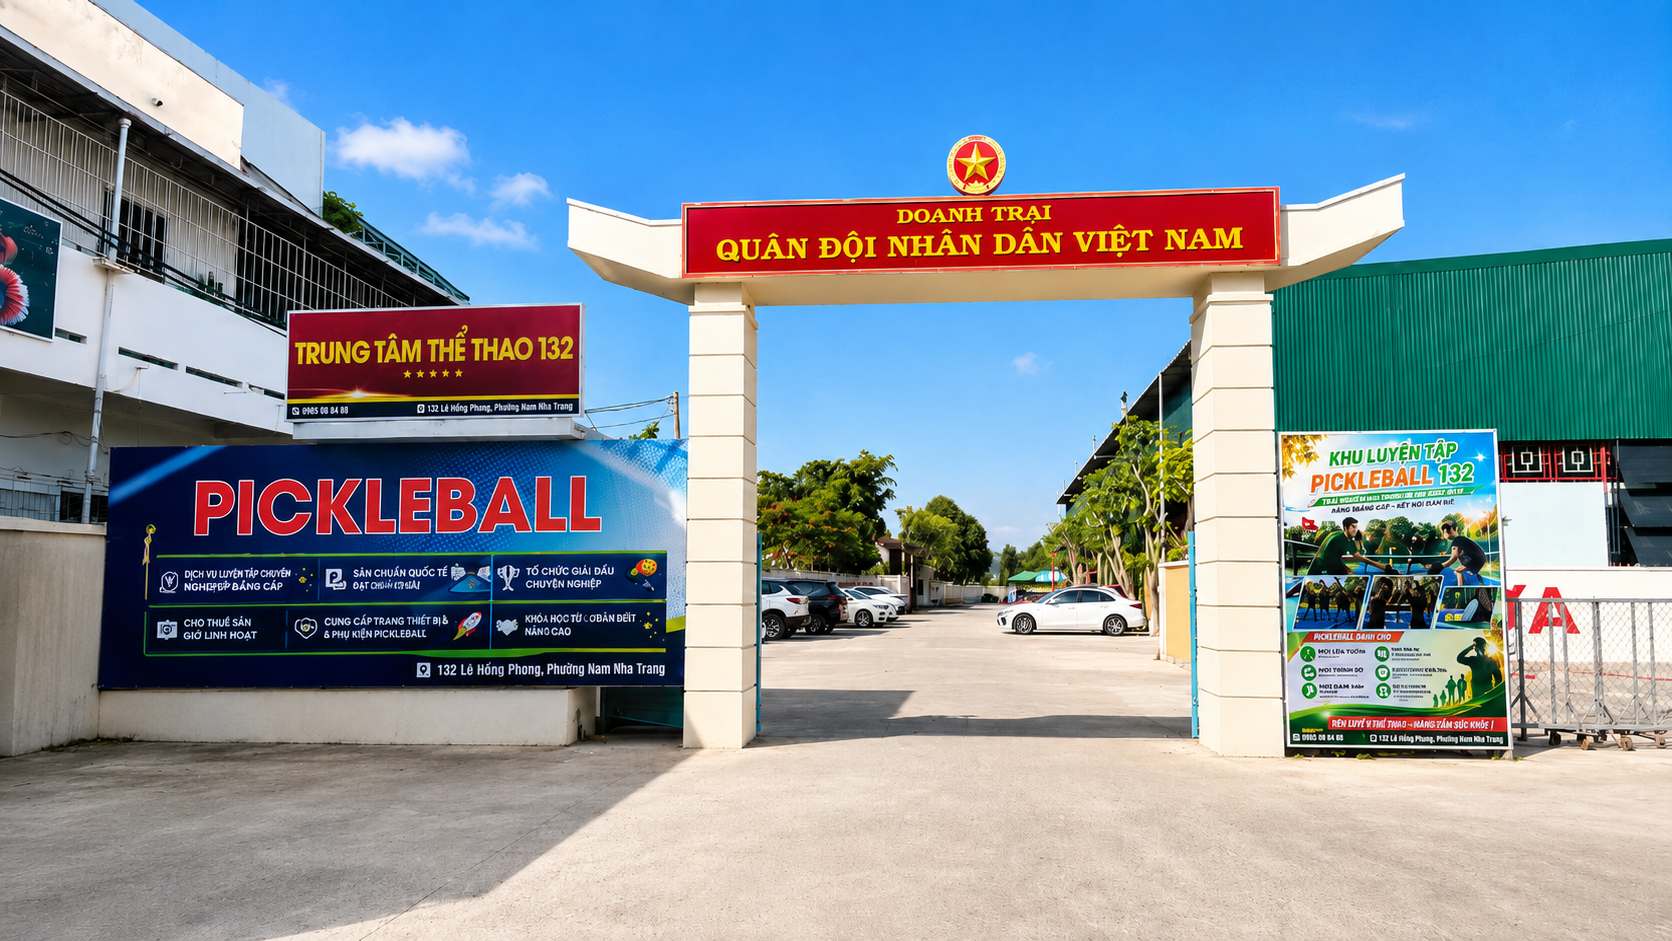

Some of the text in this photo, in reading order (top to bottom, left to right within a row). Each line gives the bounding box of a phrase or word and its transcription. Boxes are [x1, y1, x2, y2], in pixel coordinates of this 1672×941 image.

[897, 205, 1051, 225] DOANH TRẠI
[716, 223, 1244, 264] QUÂN ĐỘI NHÂN DÂN VIỆT NAM
[295, 325, 573, 364] TRUNG TÂM THỂ THAO 132
[427, 405, 438, 413] 132
[1329, 439, 1457, 467] KHU LUYỆN TẬP
[1311, 463, 1474, 493] PICKLEBALL 132
[193, 475, 602, 537] PICKLEBALL
[408, 565, 435, 577] QUỐC
[567, 578, 602, 590] NGHIỆP
[184, 619, 205, 628] CHO
[324, 617, 351, 626] CUNG
[373, 617, 404, 626] TRANG
[205, 631, 227, 640] LINH
[230, 631, 258, 642] HOẠT
[374, 629, 427, 639] PICKLEBALL
[551, 627, 571, 636] CAO
[437, 664, 457, 676] 132
[461, 664, 473, 675] Lê
[508, 664, 544, 677] Phong,
[588, 663, 610, 675] Nam
[614, 663, 633, 675] Nha
[637, 663, 665, 677] Trang
